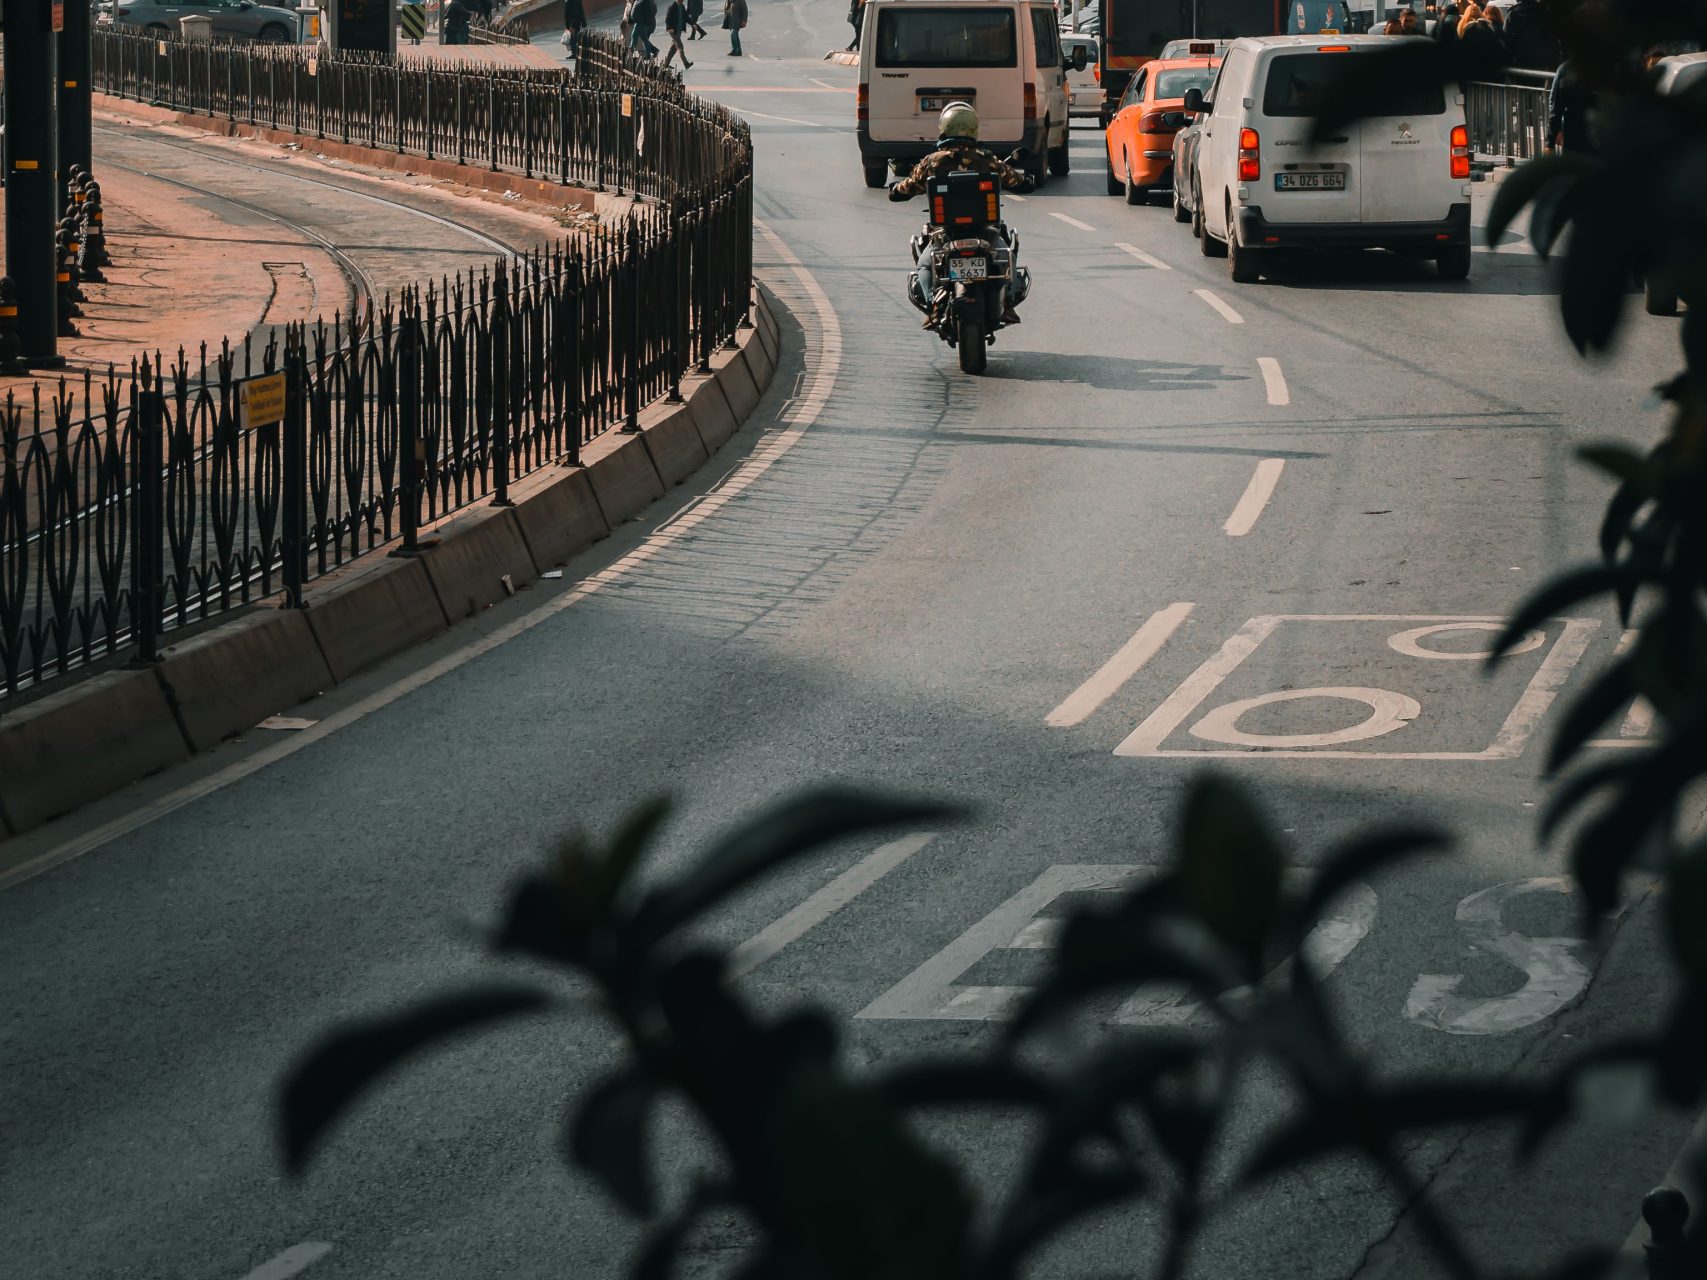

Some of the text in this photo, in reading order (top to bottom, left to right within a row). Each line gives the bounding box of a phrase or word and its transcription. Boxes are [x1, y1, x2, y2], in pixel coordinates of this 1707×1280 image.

[1282, 175, 1295, 187] 34
[1322, 175, 1342, 187] 664
[951, 260, 964, 268] 35
[960, 269, 985, 278] 5637
